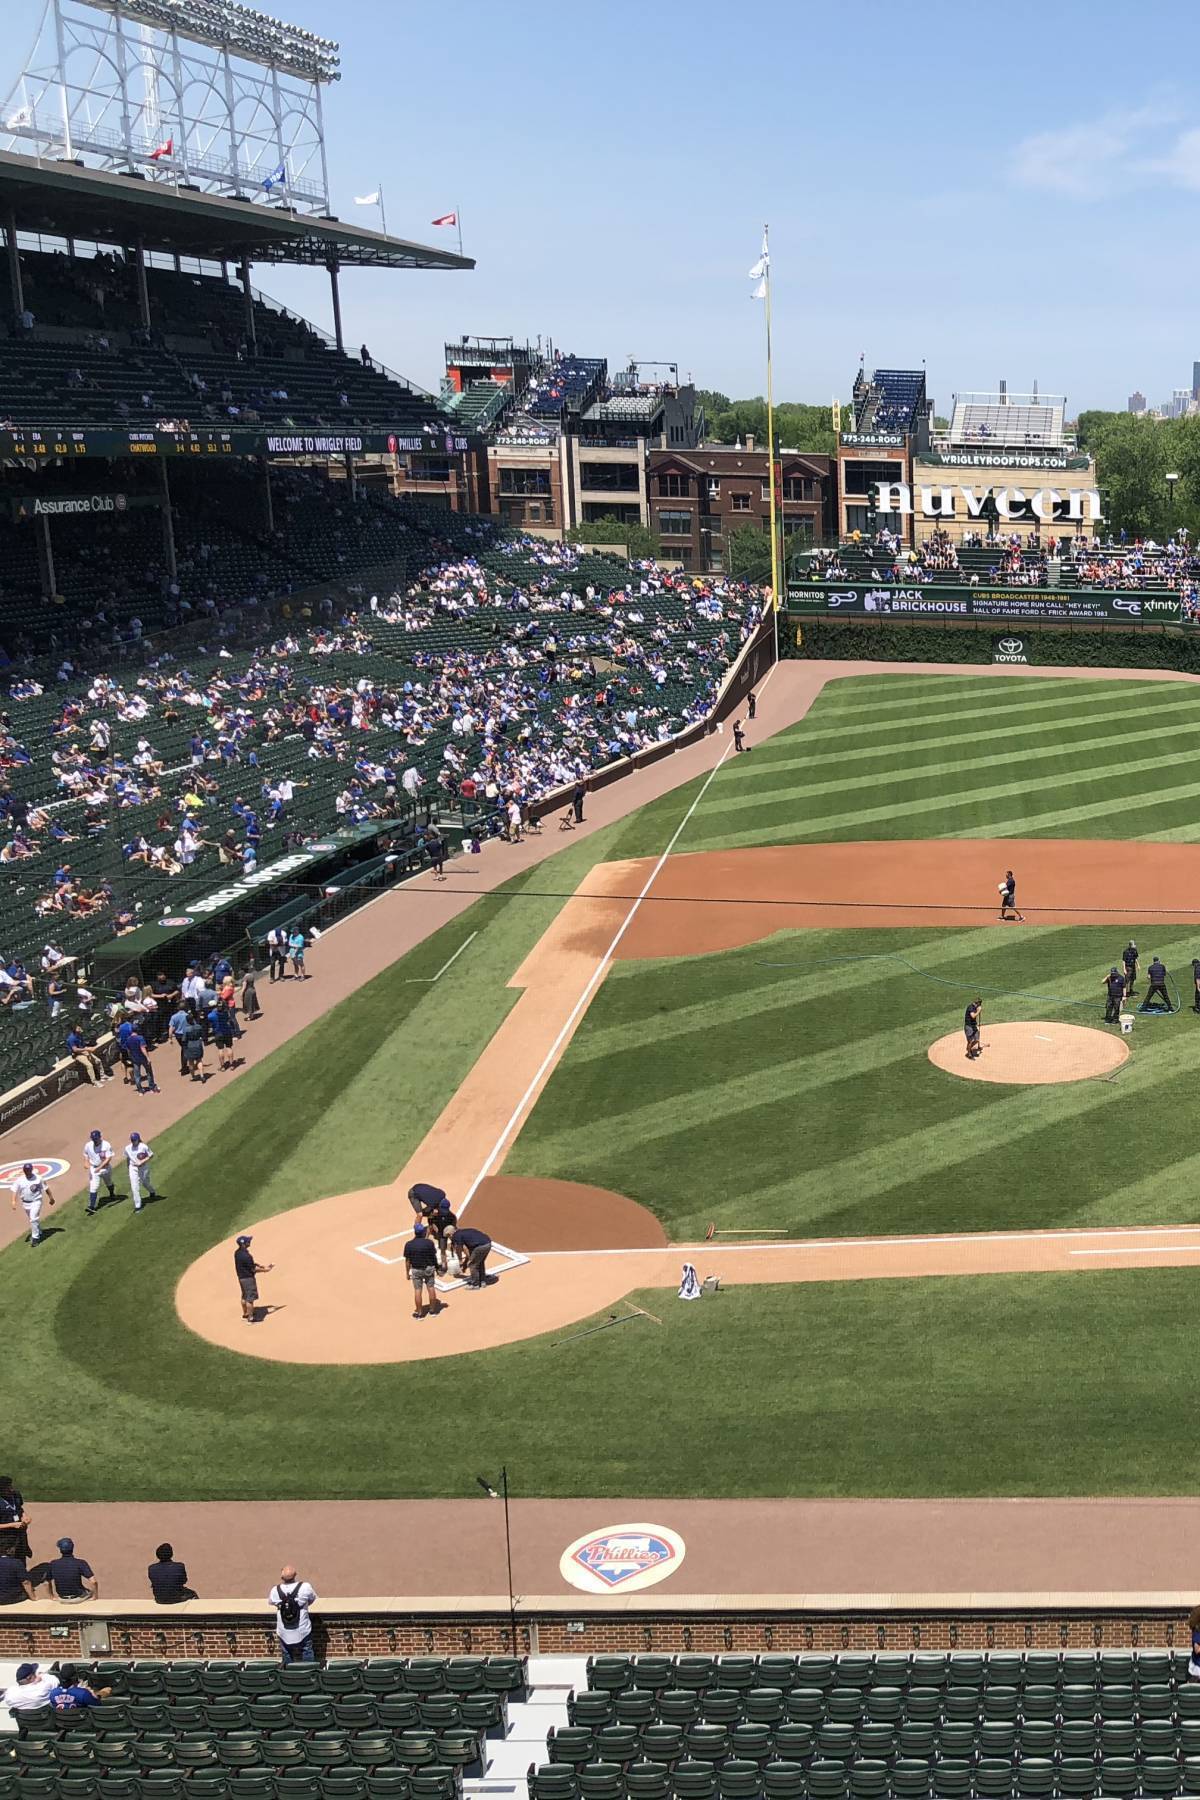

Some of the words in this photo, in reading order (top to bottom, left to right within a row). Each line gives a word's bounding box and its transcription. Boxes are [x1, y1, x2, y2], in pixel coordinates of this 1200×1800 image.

[267, 437, 304, 451] WELCOME
[304, 438, 314, 450] TO
[314, 437, 344, 451] WRIGLEY
[345, 437, 362, 451] FIELD
[399, 437, 422, 450] PHILLIES
[455, 437, 468, 449] CUBS
[842, 434, 902, 446] 773-248-ROOF
[130, 443, 157, 453] CHATWOOD
[941, 455, 1067, 468] WRIGLEYROOFTOPS.COM
[34, 498, 90, 514] Assurance
[91, 496, 114, 512] Club
[874, 480, 1105, 520] nuveen
[789, 590, 825, 599] HORNITOS
[892, 590, 923, 600] JACK
[892, 601, 967, 613] BRICKHOUSE
[1143, 599, 1179, 613] xfinity
[994, 655, 1027, 663] TOYOTA
[233, 854, 314, 889] CHICAGO
[185, 888, 248, 912] CUBS
[587, 1544, 661, 1561] Phillies
